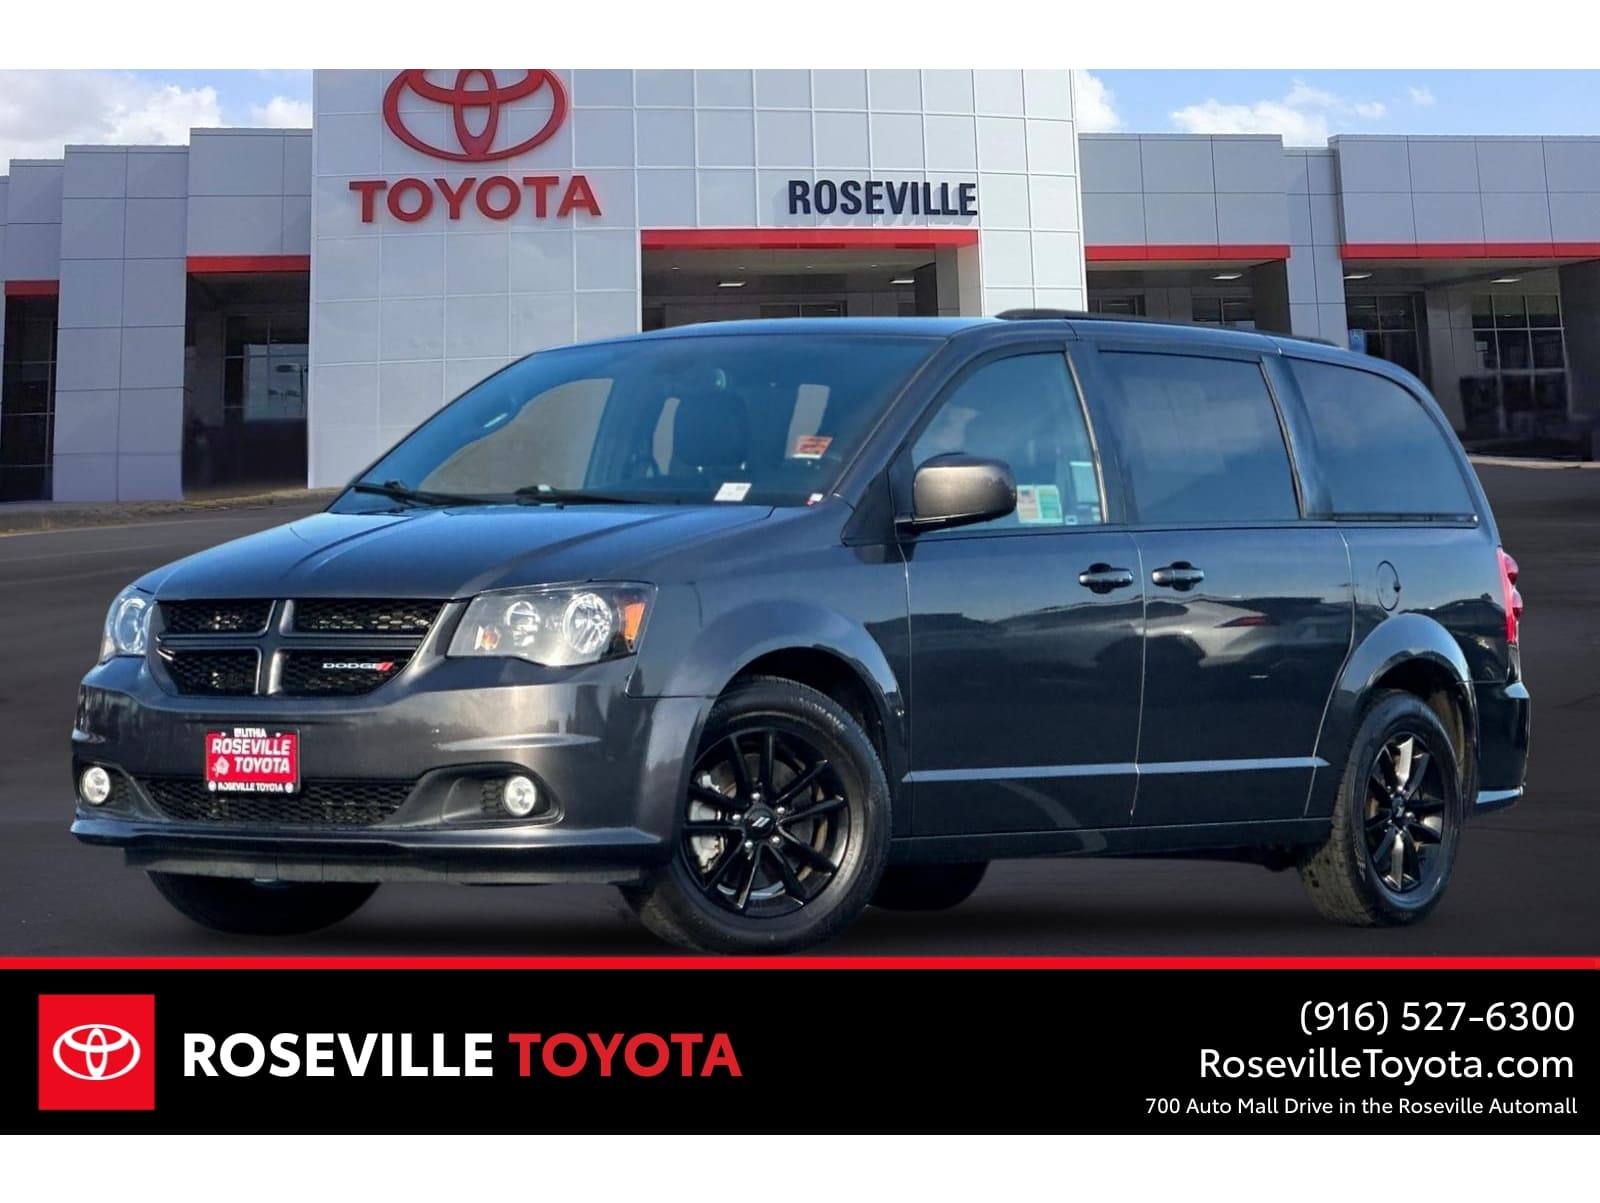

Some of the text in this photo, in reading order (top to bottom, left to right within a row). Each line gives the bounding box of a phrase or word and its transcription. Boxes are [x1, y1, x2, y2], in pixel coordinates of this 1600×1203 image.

[350, 175, 602, 223] TOYOTA
[788, 180, 978, 216] ROSEVILLE
[323, 662, 380, 670] DODGE
[211, 738, 291, 756] ROSEVILLE
[234, 756, 290, 774] TOYOTA
[217, 782, 283, 792] ROSEVILLE TOYOTA
